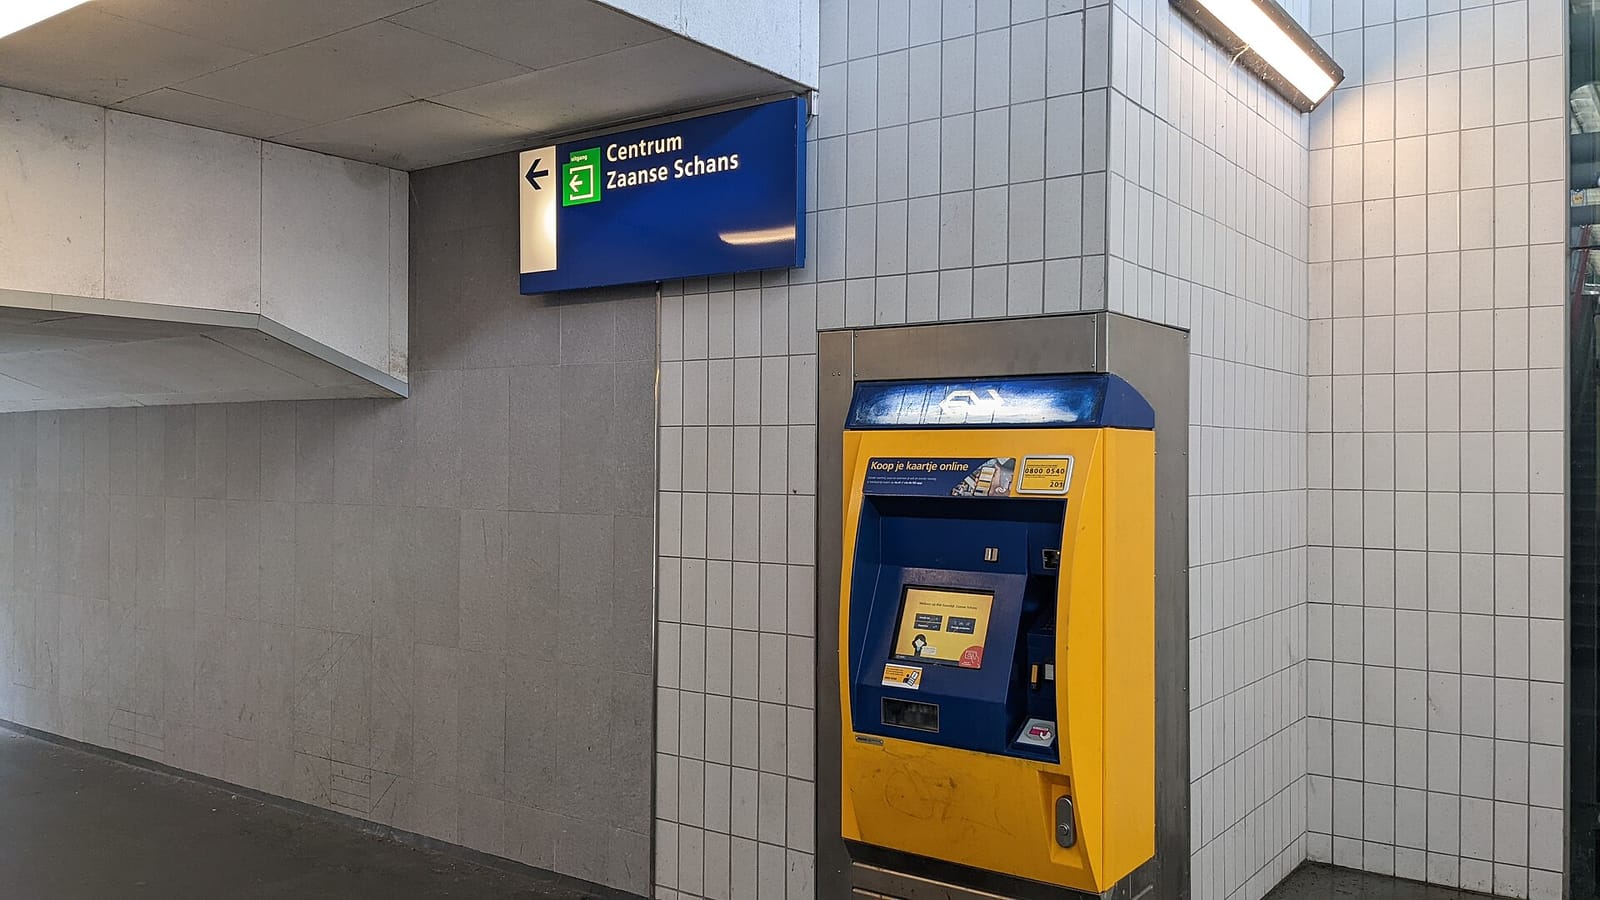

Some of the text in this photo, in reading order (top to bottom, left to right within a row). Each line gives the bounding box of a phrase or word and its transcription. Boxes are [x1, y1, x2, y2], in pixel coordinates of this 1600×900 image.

[570, 154, 588, 162] uitgang
[606, 135, 682, 162] Centrum
[606, 153, 739, 190] Zaanse Schans
[870, 461, 969, 473] Koop je kaartje online
